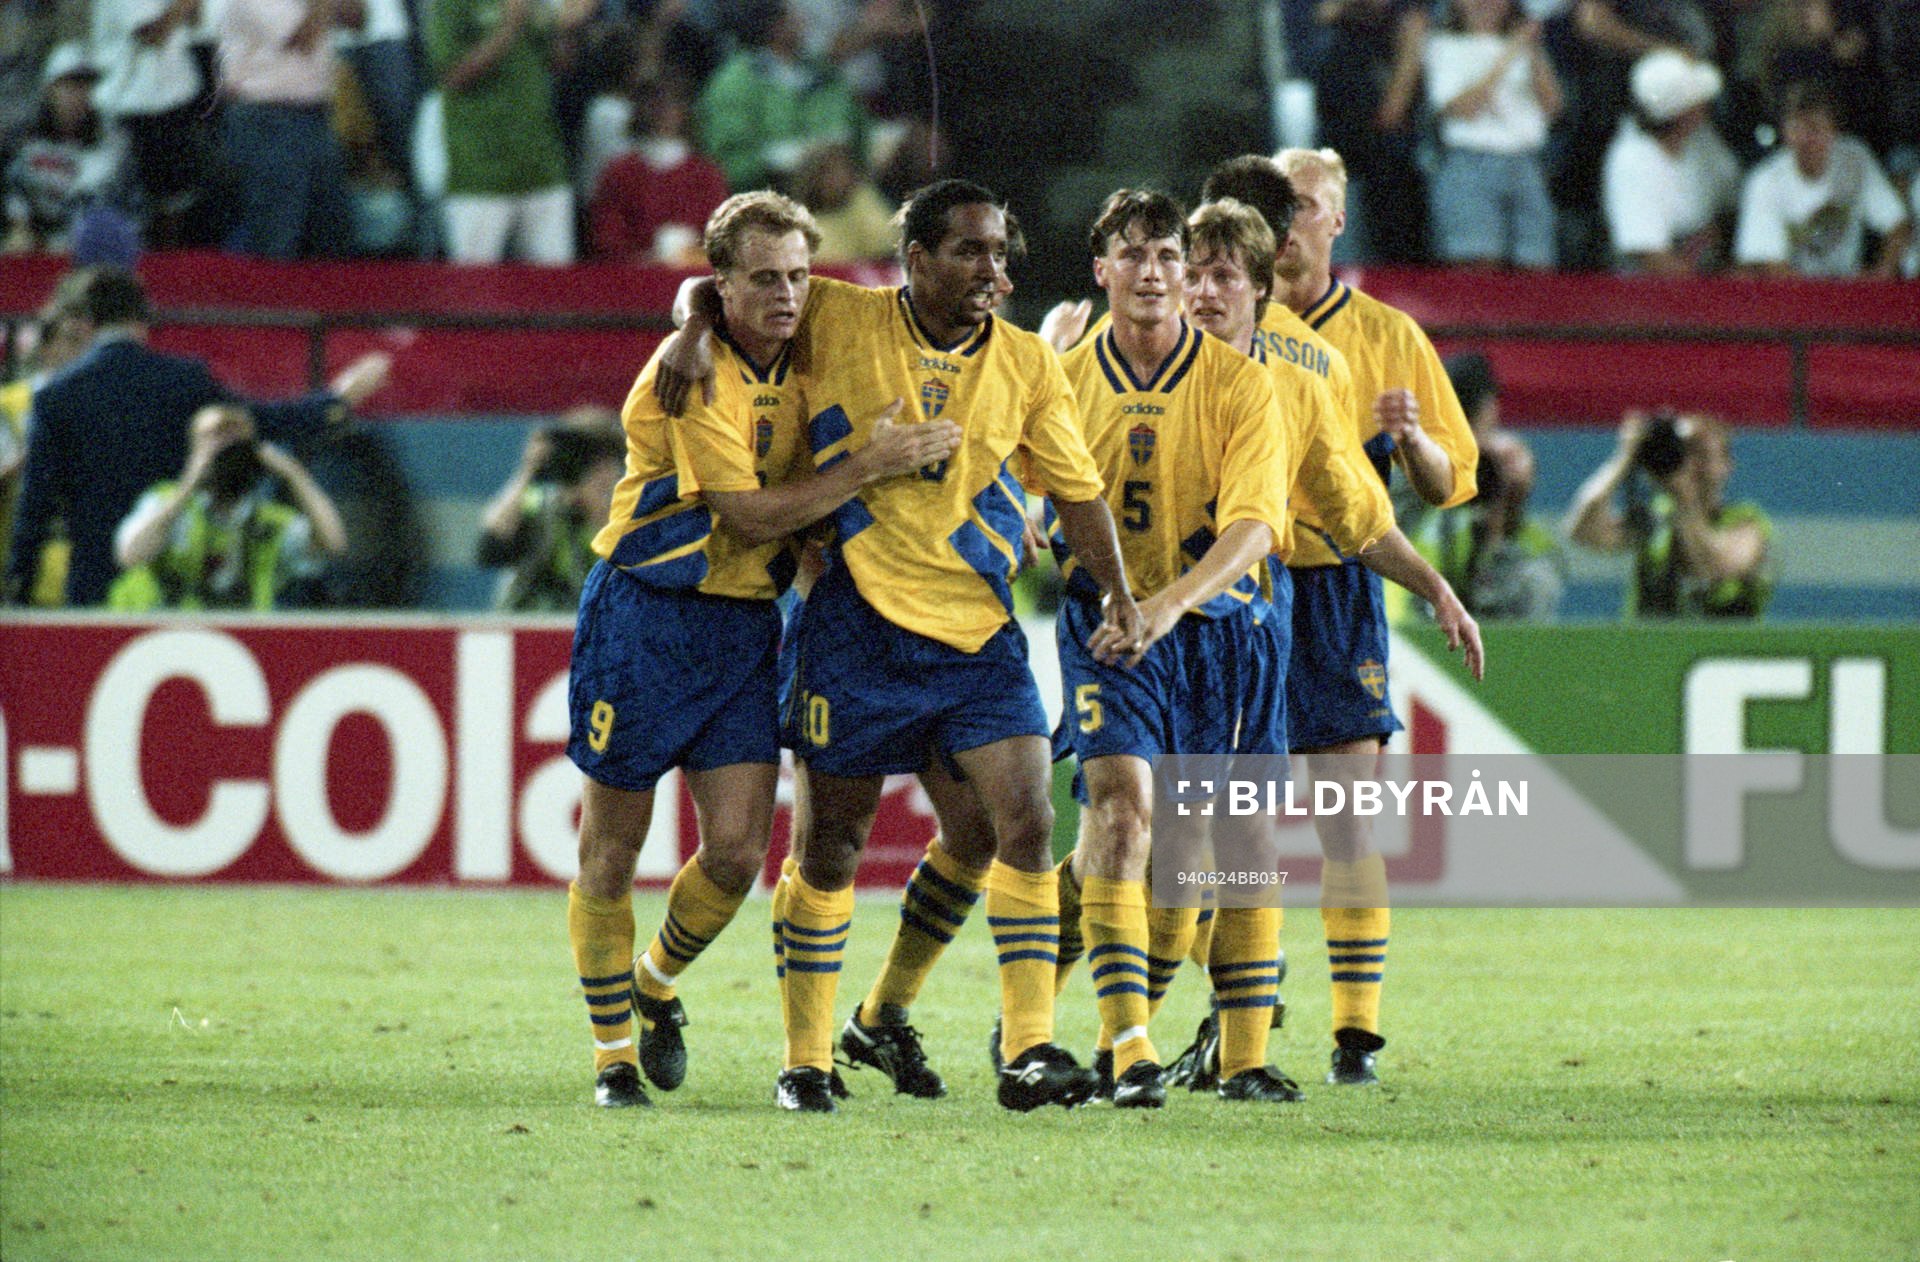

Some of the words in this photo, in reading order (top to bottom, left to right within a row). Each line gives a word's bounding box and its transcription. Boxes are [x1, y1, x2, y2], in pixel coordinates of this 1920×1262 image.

[1122, 402, 1165, 415] adidas
[1123, 480, 1152, 531] 5
[588, 700, 615, 753] 9
[1075, 684, 1103, 734] 5
[0, 627, 681, 880] -Cola
